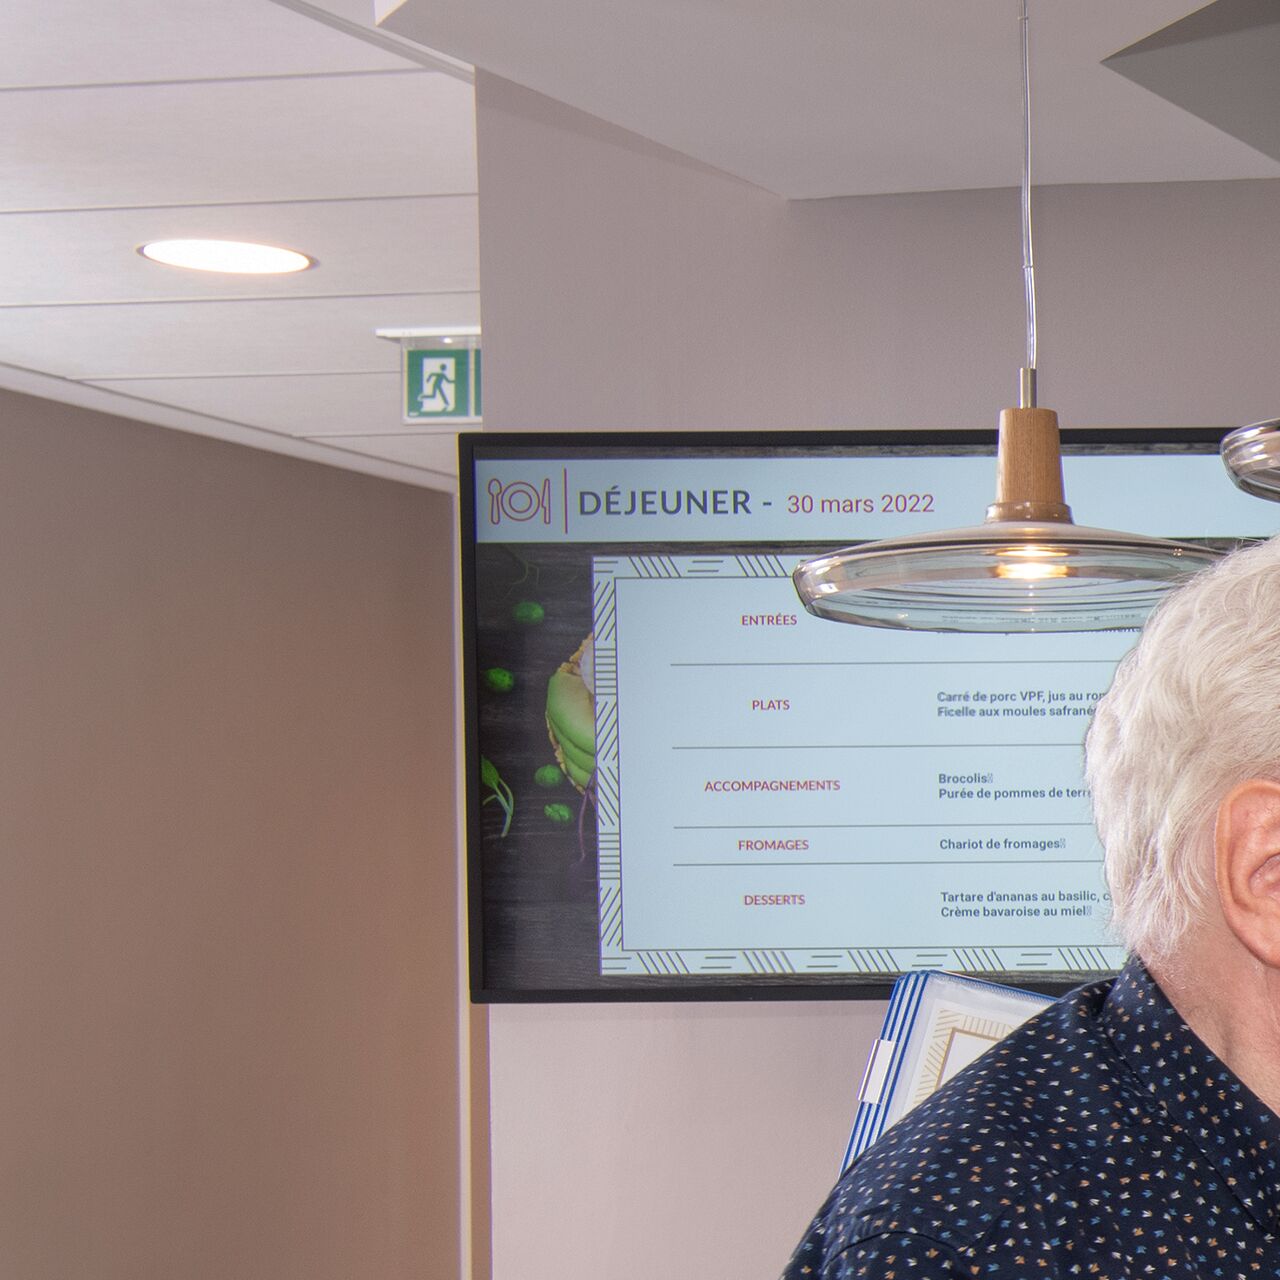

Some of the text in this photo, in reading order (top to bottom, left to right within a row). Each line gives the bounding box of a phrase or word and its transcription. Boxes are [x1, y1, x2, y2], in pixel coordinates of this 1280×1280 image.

[578, 486, 752, 516] DÉJEUNER
[788, 494, 814, 513] 30
[821, 496, 874, 513] mars
[882, 494, 935, 513] 2022
[741, 614, 798, 626] ENTRÉES
[937, 691, 970, 702] Carré
[972, 691, 988, 702] de
[990, 693, 1016, 704] porc
[1020, 691, 1045, 703] VPF,
[1048, 690, 1066, 704] jus
[1069, 693, 1082, 701] au
[752, 699, 790, 711] PLATS
[937, 706, 976, 717] Ficelle
[979, 708, 999, 717] aux
[1002, 706, 1046, 716] moules
[938, 773, 988, 784] Brocolis
[704, 780, 841, 792] ACCOMPAGNEMENTS
[938, 788, 973, 799] Purée
[977, 788, 991, 798] de
[994, 789, 1046, 800] pommes
[1049, 788, 1062, 798] de
[738, 840, 809, 851] FROMAGES
[940, 838, 1060, 851] Chariot de fromages
[744, 895, 806, 906] DESSERTS
[941, 891, 984, 902] Tartare
[986, 891, 1038, 902] d'ananas
[1042, 893, 1055, 902] au
[1058, 890, 1100, 904] basilic,
[941, 906, 1086, 917] Crème bavaroise au miel
